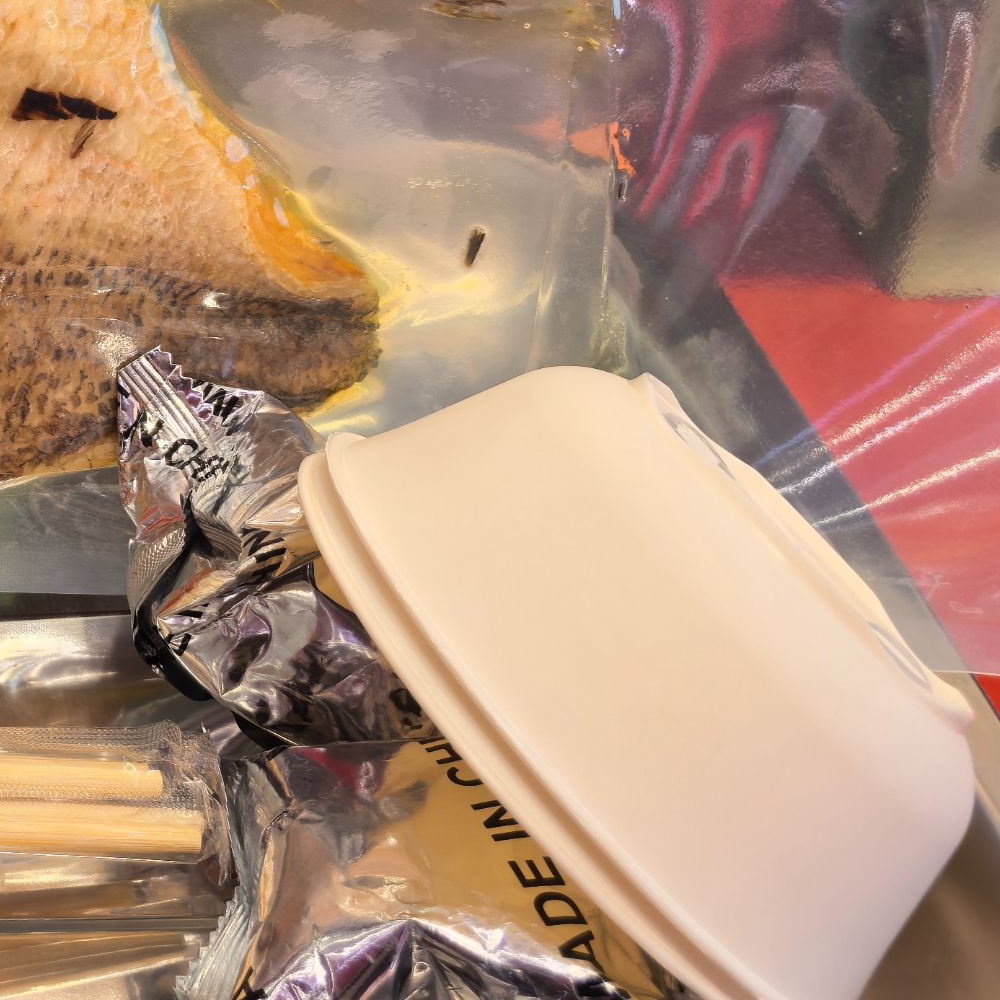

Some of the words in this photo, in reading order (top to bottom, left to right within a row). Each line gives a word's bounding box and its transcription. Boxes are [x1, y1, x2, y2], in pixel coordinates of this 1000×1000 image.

[418, 736, 485, 788] CHI
[470, 799, 531, 842] IN
[507, 855, 606, 976] ADE
